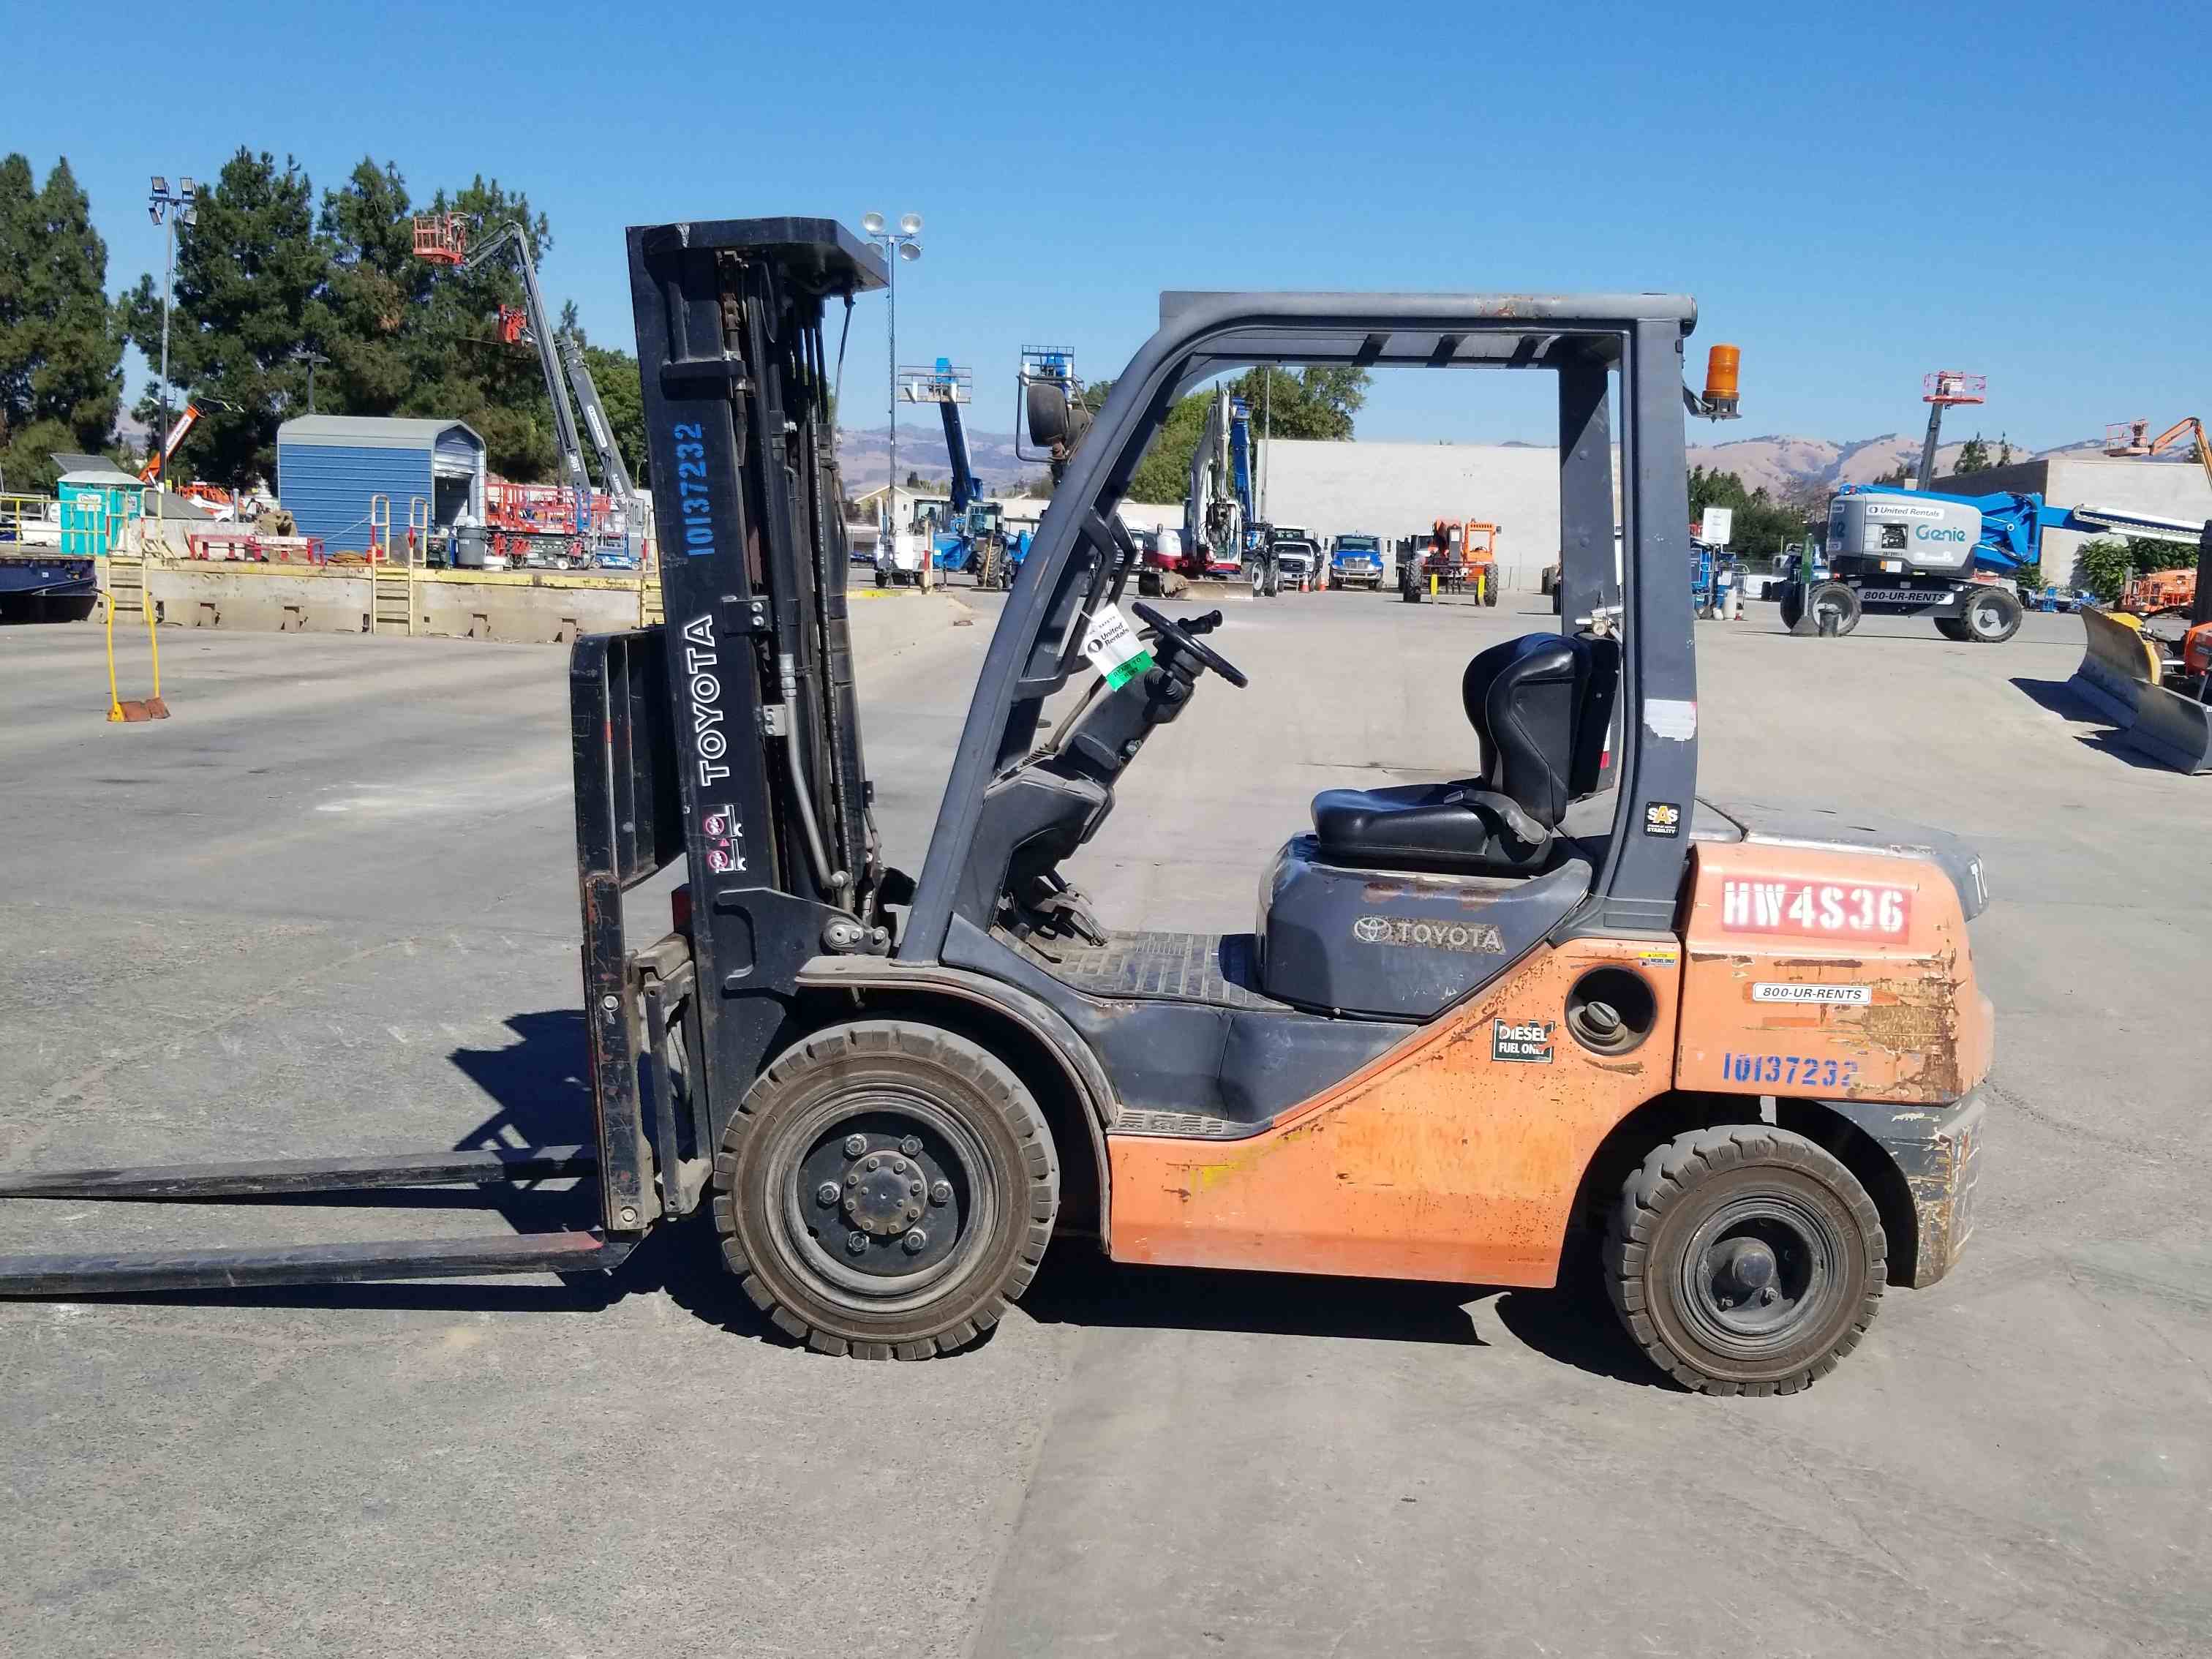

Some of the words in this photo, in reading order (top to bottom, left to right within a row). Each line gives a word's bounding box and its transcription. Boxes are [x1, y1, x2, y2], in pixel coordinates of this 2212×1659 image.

[674, 423, 715, 556] 10137232
[1881, 506, 1908, 515] United
[1911, 508, 1940, 518] Rentals
[1916, 524, 1965, 542] Genie
[1864, 591, 1946, 601] 800-UR-RENTS
[1101, 622, 1124, 640] United
[1105, 628, 1130, 647] Rentals
[684, 614, 732, 786] TOYOTA
[1647, 805, 1678, 824] SAS
[1723, 881, 1903, 933] HW4S36
[1397, 922, 1502, 951] TOYOTA
[1762, 987, 1862, 1000] 800-UR-RENTS
[1498, 1026, 1548, 1042] DIESEL
[1499, 1042, 1520, 1053] FUEL
[1723, 1053, 1858, 1087] 10137232
